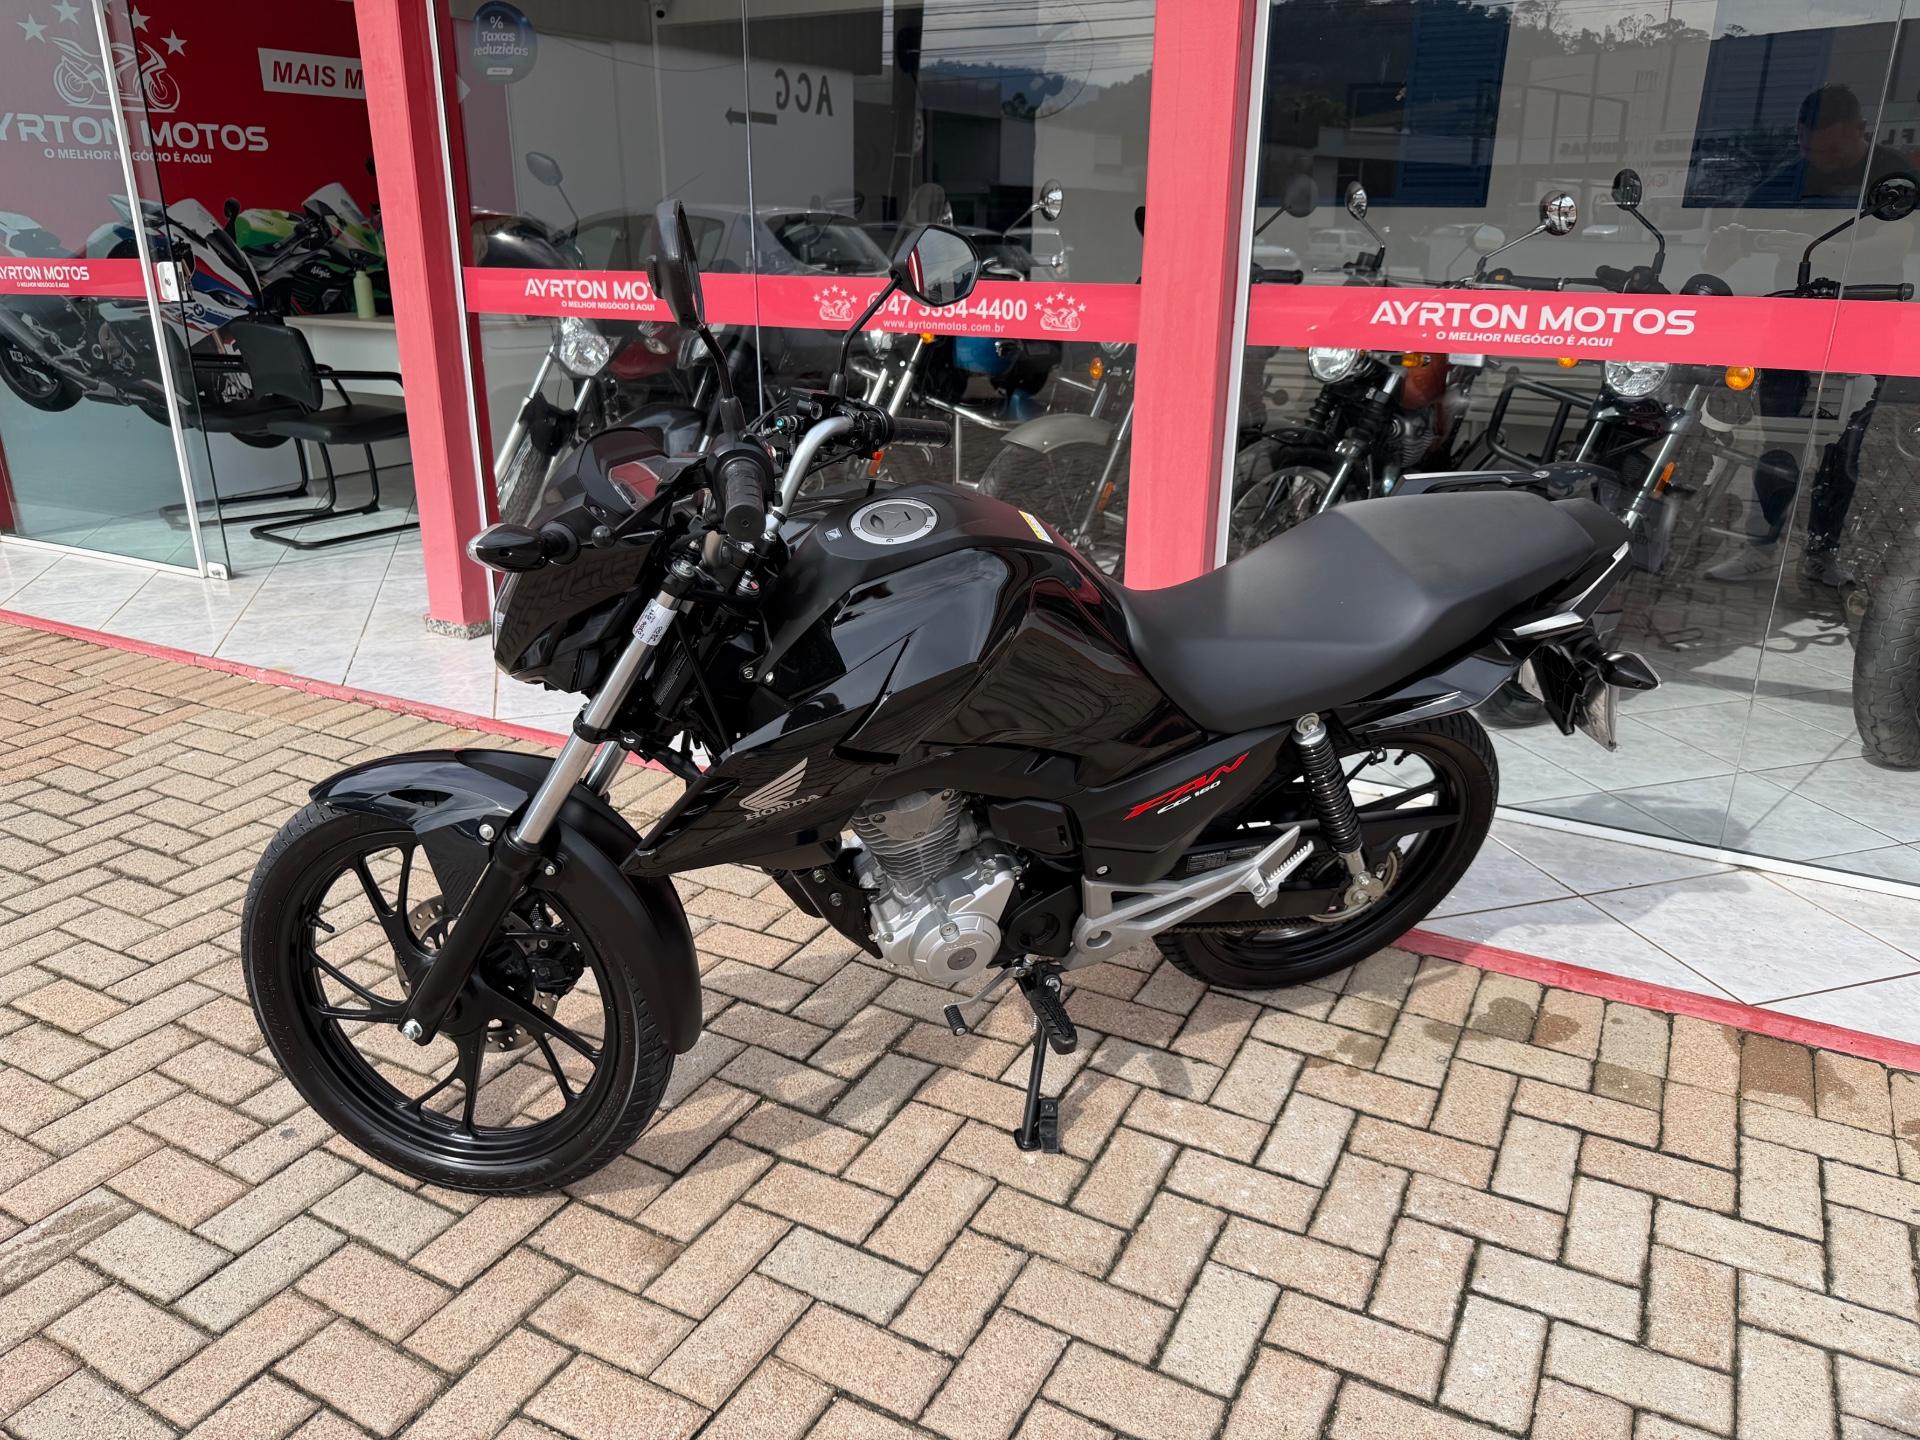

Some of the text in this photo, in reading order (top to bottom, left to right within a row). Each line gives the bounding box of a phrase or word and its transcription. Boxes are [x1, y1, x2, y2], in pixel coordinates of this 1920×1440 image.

[481, 31, 516, 42] Taxas
[473, 43, 529, 56] reduzidas
[272, 60, 336, 88] MAIS
[142, 120, 268, 151] MOTOS
[44, 148, 212, 165] O MELHOR NGÓCIO É AQUI
[43, 265, 90, 281] MOTOS
[524, 278, 658, 302] AYRTON MOT
[568, 301, 597, 310] MELHOR
[598, 301, 629, 311] NEGÓCIO
[636, 304, 656, 312] AQUI
[887, 295, 911, 315] 47
[883, 320, 1005, 333] www.ayrtonmotos.com.br
[1368, 300, 1697, 336] AYRTON MOTOS
[1436, 331, 1613, 347] O MELHOR NEGÓCIO É AQUI
[1157, 779, 1221, 815] CG 160
[743, 793, 824, 821] HONDA
